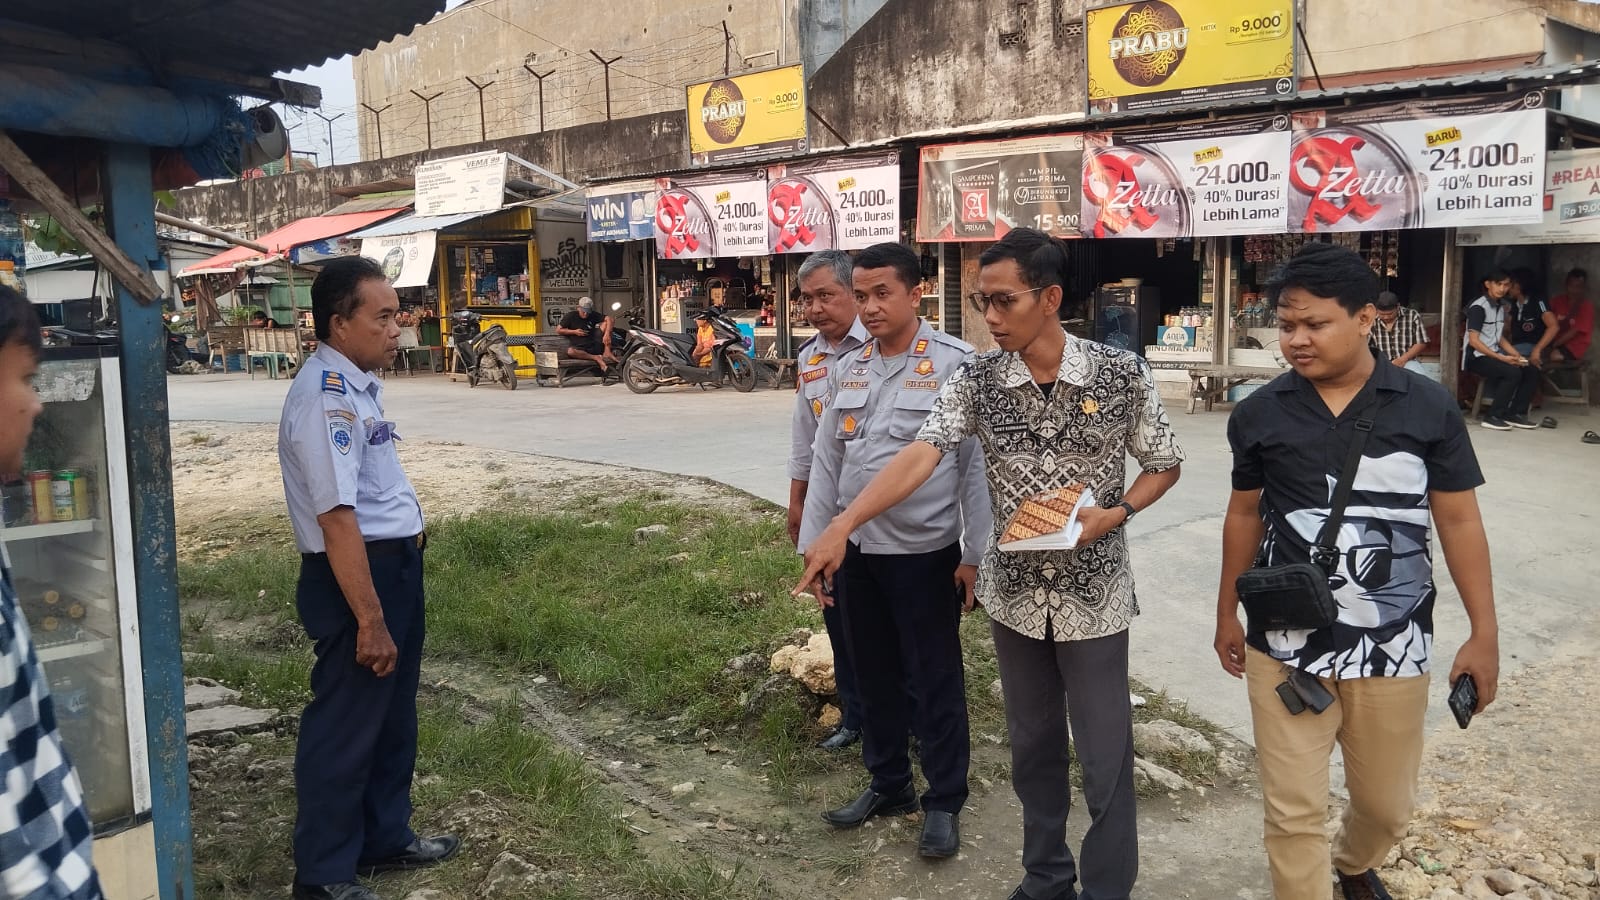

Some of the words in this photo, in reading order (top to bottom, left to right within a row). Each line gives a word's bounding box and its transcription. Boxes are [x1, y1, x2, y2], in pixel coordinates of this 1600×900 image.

[1230, 26, 1241, 34] Rp
[1108, 27, 1190, 60] PRABU
[702, 99, 747, 123] PRABU
[1426, 128, 1460, 145] BARU!
[1429, 142, 1519, 172] 24.000
[957, 173, 995, 183] SAMPOERNA
[1028, 167, 1059, 176] TAMPIL
[1038, 175, 1067, 183] PRIMA
[1196, 161, 1269, 187] 24.000
[1318, 165, 1409, 200] Zetta
[1438, 174, 1472, 191] 40%
[1478, 171, 1533, 189] Durasi
[840, 189, 886, 209] 24.000
[1108, 181, 1179, 209] Zetta
[1204, 189, 1231, 204] 40%
[1235, 187, 1280, 202] Durasi
[1437, 195, 1480, 211] Lebih
[590, 198, 625, 221] WIN
[718, 202, 757, 219] 24.000
[785, 205, 832, 230] Zetta
[846, 212, 862, 223] 40%
[864, 209, 894, 222] Durasi
[1203, 208, 1239, 222] Lebih
[1563, 207, 1577, 217] Rp
[672, 216, 710, 236] Zetta
[739, 220, 764, 232] Durasi
[845, 227, 868, 238] Lebih
[965, 223, 987, 232] PRIMA
[723, 236, 743, 246] Lebih
[549, 278, 585, 287] WELCOME
[1166, 333, 1185, 341] AQUA
